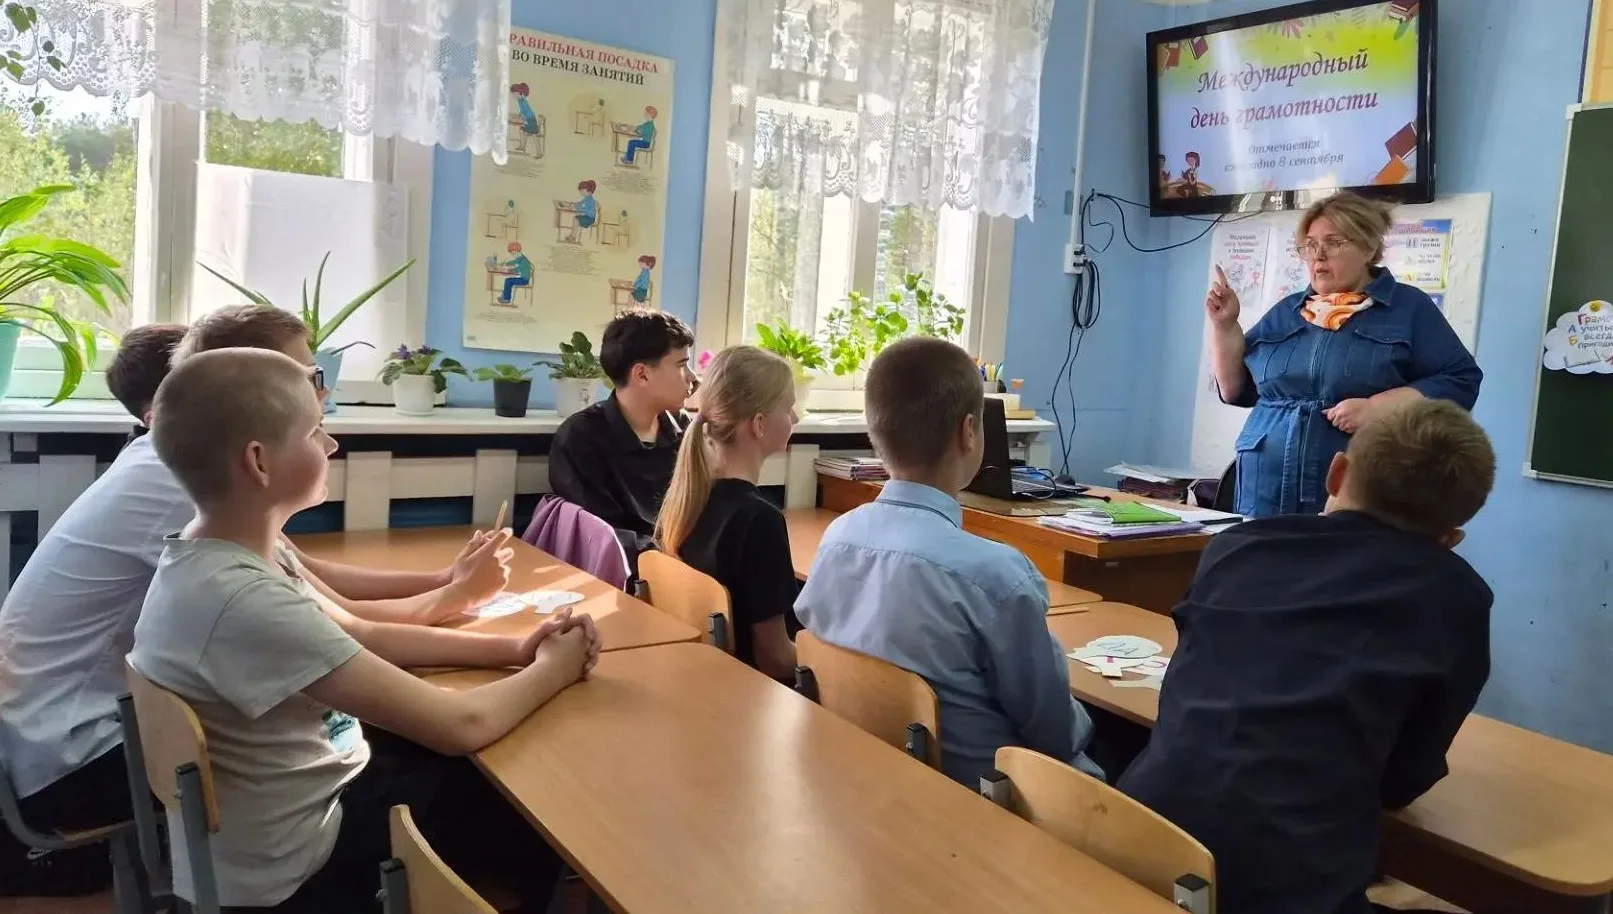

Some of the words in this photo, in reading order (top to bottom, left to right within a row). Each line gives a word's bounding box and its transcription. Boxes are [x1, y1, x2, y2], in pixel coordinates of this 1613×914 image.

[510, 33, 595, 60] РАВИЛЬНАЯ
[599, 50, 659, 74] ПОСАДКА
[511, 50, 530, 62] ВО
[533, 53, 579, 73] ВРЕМЯ
[581, 63, 645, 86] ЗАНЯТИЙ
[1197, 48, 1369, 93] Международный
[1190, 106, 1230, 129] день
[1235, 92, 1379, 130] грамотности
[1249, 138, 1321, 156] Отмечается
[1288, 152, 1345, 169] сентября
[1577, 313, 1613, 325] Грамо
